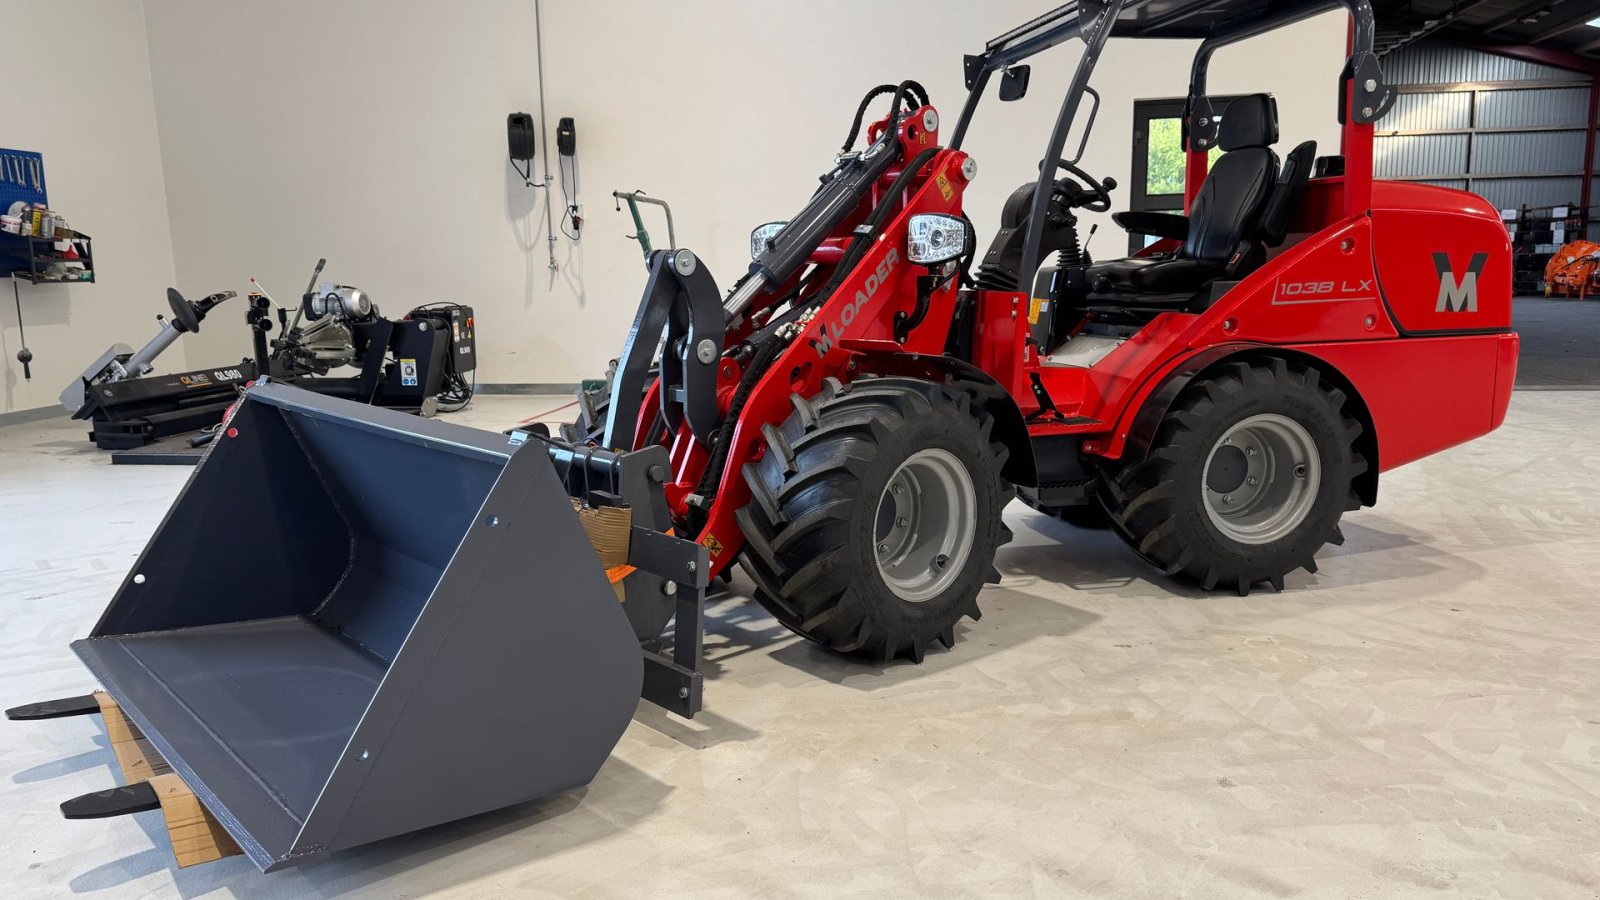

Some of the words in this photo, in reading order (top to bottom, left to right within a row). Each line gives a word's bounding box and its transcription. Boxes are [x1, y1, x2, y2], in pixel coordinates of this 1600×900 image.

[1281, 281, 1334, 295] 1038
[1341, 279, 1372, 292] LX
[213, 369, 242, 381] QL980
